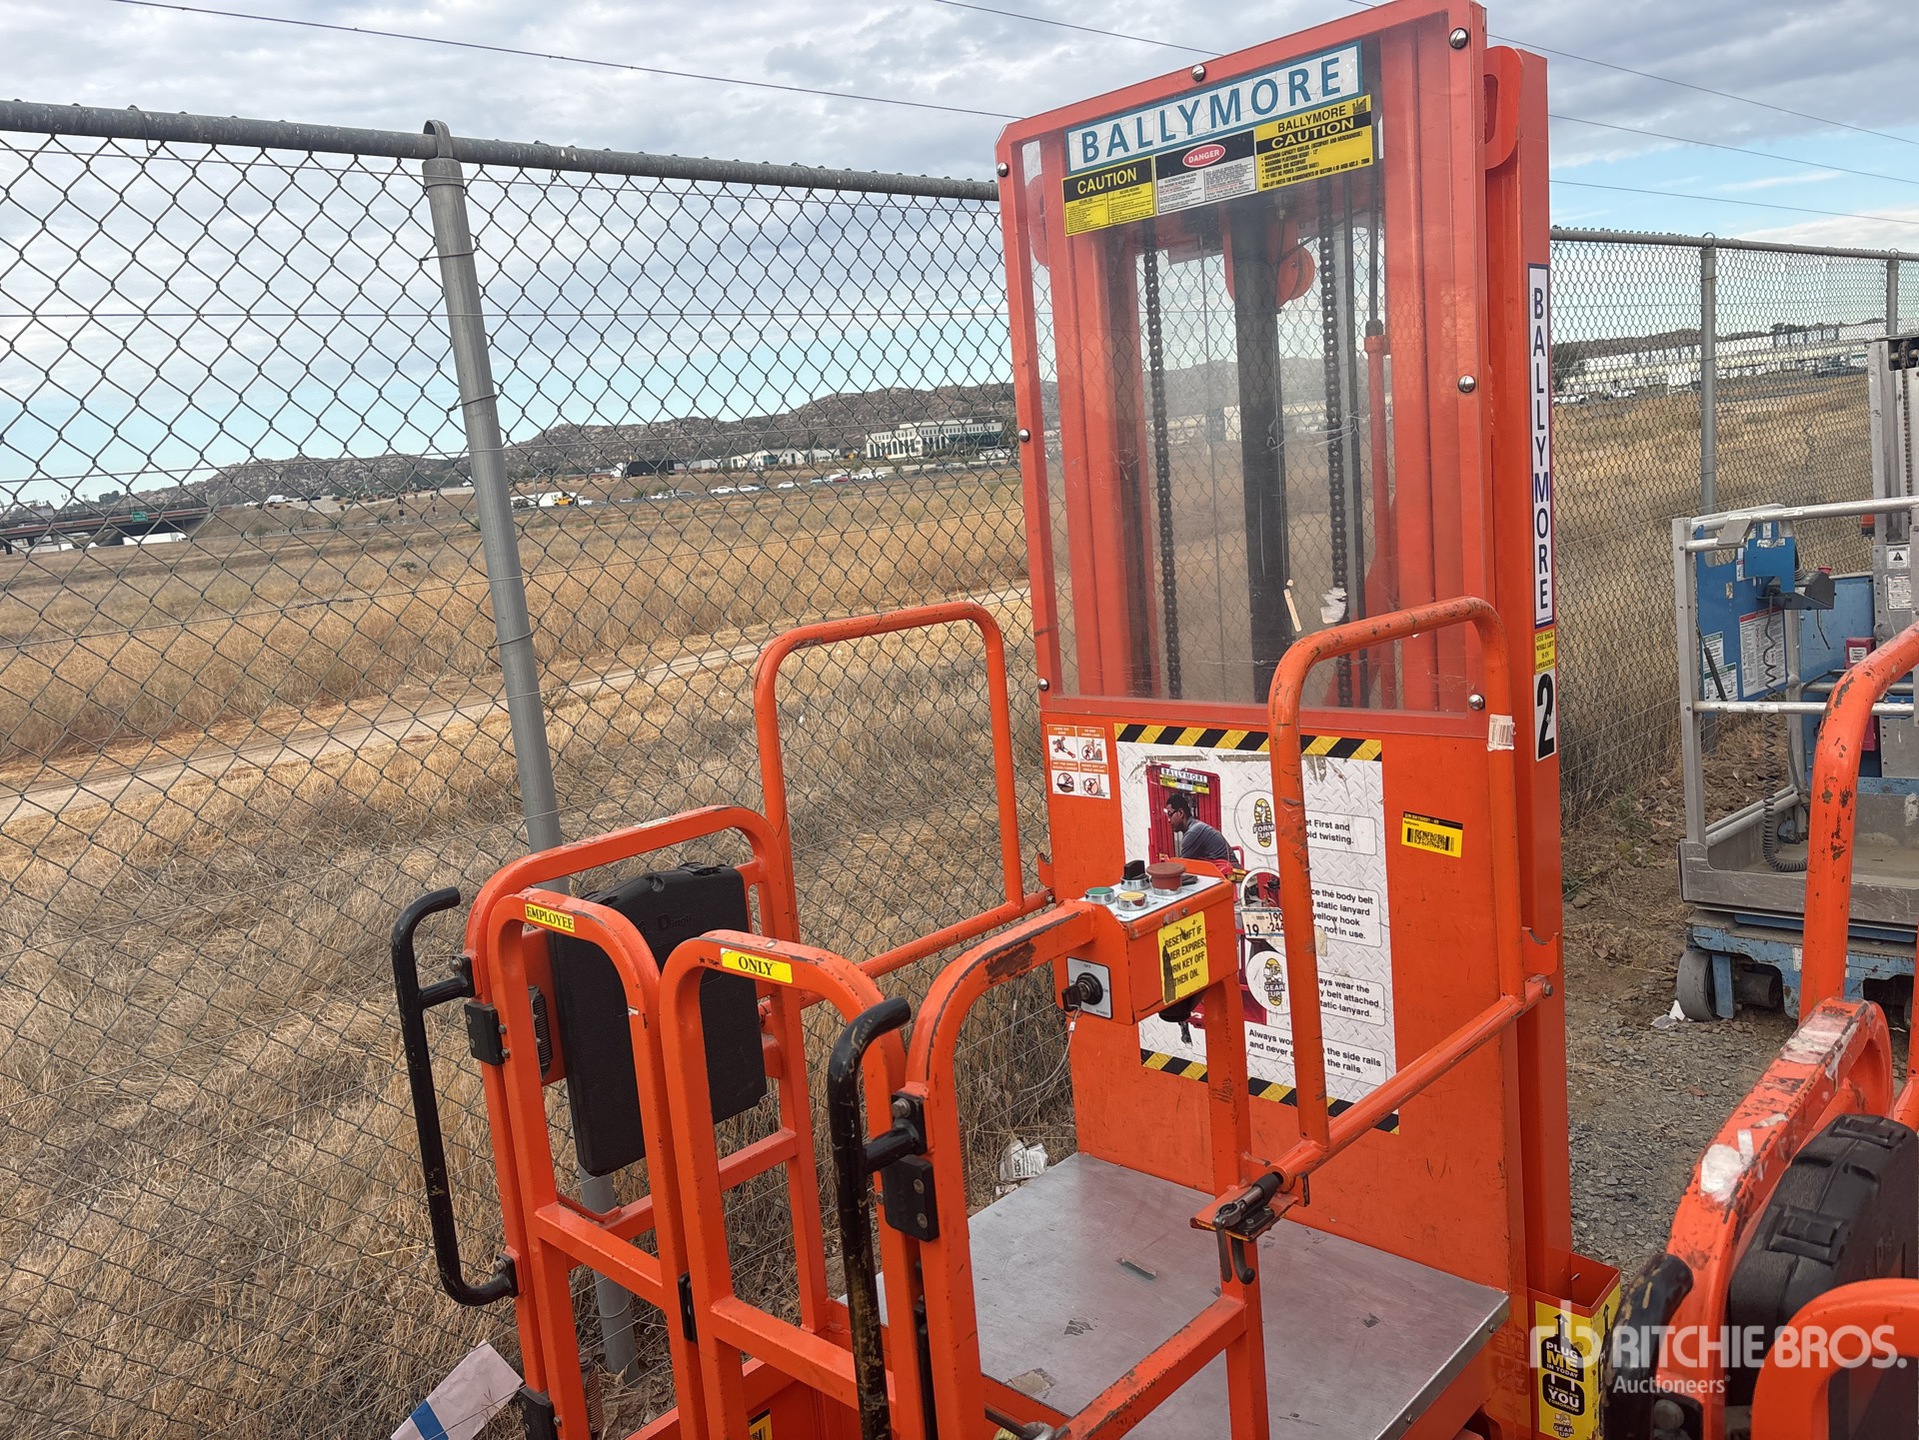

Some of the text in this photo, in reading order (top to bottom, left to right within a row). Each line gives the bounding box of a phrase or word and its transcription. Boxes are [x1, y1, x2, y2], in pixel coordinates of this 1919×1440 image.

[1082, 56, 1340, 163] BALLYMORE
[1278, 105, 1346, 133] BALLYMORE
[1271, 118, 1354, 149] CAUTION
[1188, 149, 1220, 163] DANGER
[1077, 167, 1137, 194] CAUTION
[1533, 287, 1549, 609] BALLYMORE
[1537, 673, 1555, 759] 2
[1164, 769, 1206, 782] BALLYMORE
[1253, 824, 1274, 833] FORM
[1313, 820, 1333, 829] First
[1334, 822, 1350, 831] and
[1318, 832, 1354, 845] twisting.
[1321, 890, 1335, 898] the
[1336, 892, 1356, 903] body
[1358, 895, 1373, 905] belt
[526, 904, 574, 930] EMPLOYEE
[1317, 901, 1338, 911] static
[1340, 904, 1370, 917] lanyard
[1312, 911, 1360, 926] yellow hook
[1165, 933, 1182, 948] RESET
[1197, 924, 1202, 935] IF
[1246, 924, 1260, 936] 19
[1324, 925, 1366, 940] not in use.
[738, 955, 775, 976] ONLY
[1172, 950, 1205, 974] RN KEY OFF
[1173, 968, 1200, 986] THEN ON.
[1334, 981, 1354, 990] wear
[1356, 984, 1370, 993] the
[1327, 989, 1342, 999] belt
[1344, 994, 1379, 1008] attached
[1320, 1000, 1372, 1017] tatic lanyard.
[1249, 1029, 1381, 1067] Always wor the side rails
[1249, 1040, 1264, 1049] and
[1266, 1045, 1288, 1056] never
[1327, 1058, 1341, 1068] the
[1342, 1062, 1363, 1074] rails.
[1546, 1341, 1578, 1359] PLUG
[1547, 1350, 1578, 1373] ME
[1556, 1366, 1578, 1379] TODAY
[1548, 1388, 1579, 1408] YOU
[1548, 1397, 1580, 1413] TOMORROW
[1554, 1425, 1573, 1434] GEAR
